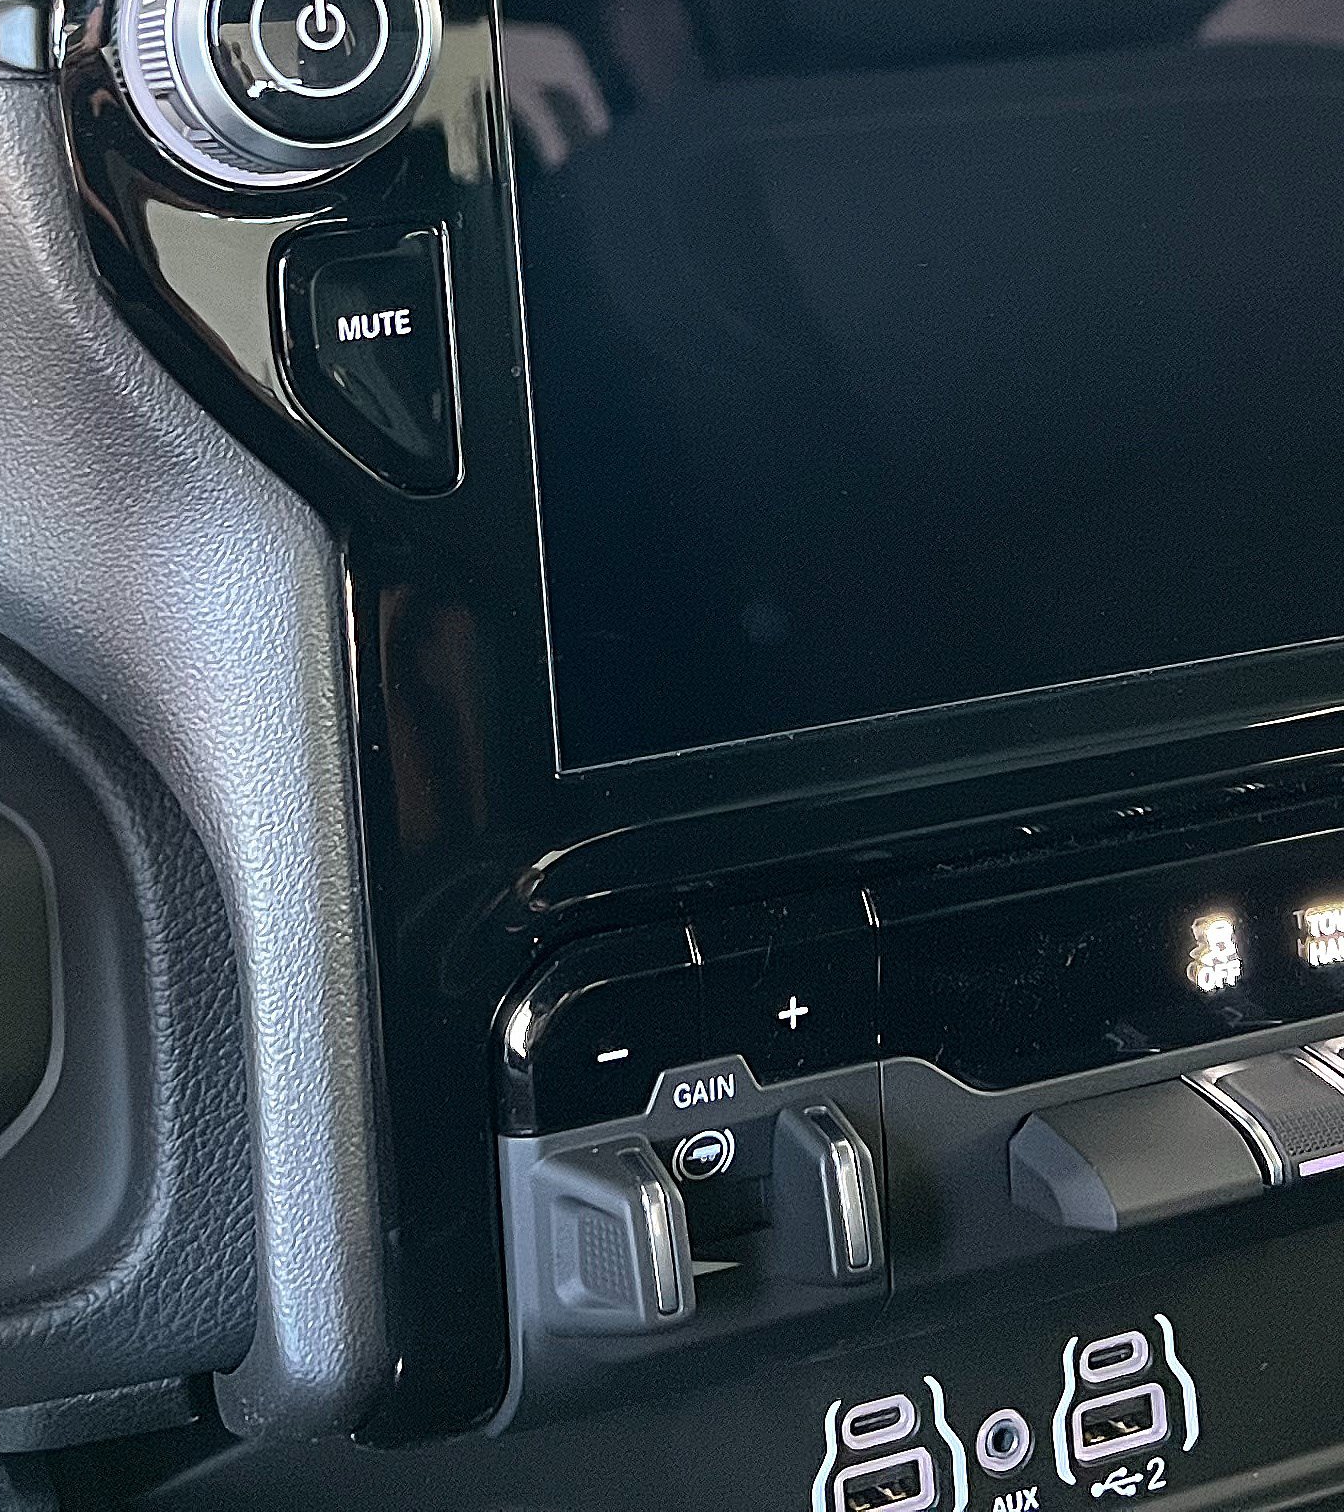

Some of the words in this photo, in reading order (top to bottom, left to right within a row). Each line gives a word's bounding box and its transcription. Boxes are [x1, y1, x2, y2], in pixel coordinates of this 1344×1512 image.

[337, 308, 413, 343] MUTE
[1197, 958, 1243, 992] OFF
[672, 1072, 736, 1110] GAIN
[1146, 1456, 1168, 1491] 2
[992, 1486, 1041, 1512] AUX
